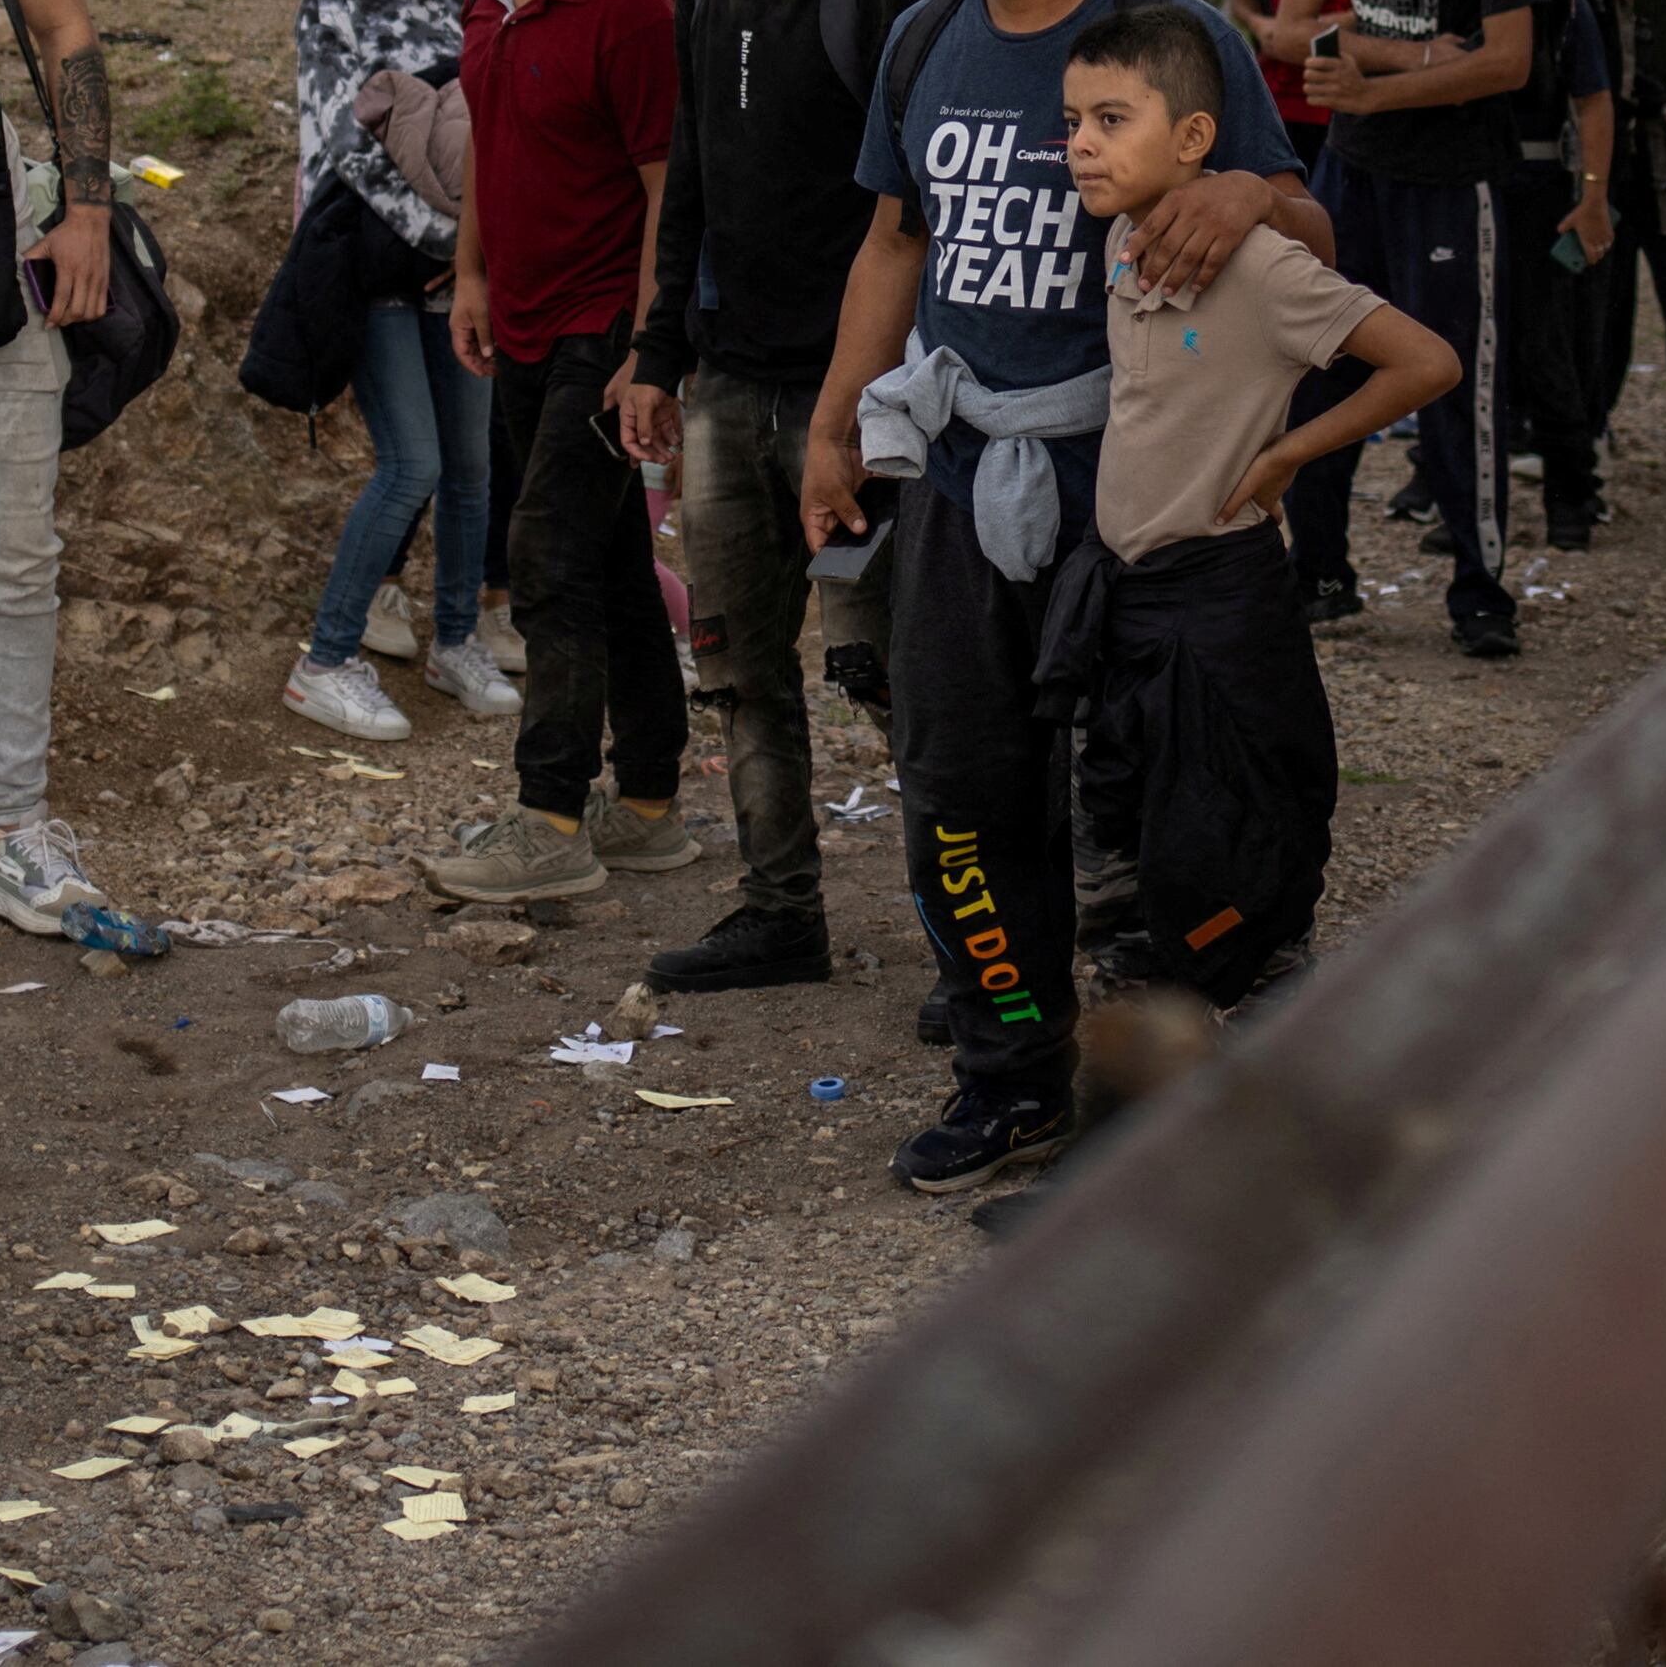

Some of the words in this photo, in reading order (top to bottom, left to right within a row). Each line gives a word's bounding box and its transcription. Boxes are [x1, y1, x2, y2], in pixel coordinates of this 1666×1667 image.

[939, 105, 949, 116] Do
[954, 107, 971, 117] work
[971, 108, 980, 117] at
[980, 108, 1006, 120] Capital
[1005, 109, 1023, 119] One?
[925, 120, 1017, 182] OH
[929, 181, 1081, 248] TECH
[935, 239, 1088, 310] YEAH
[935, 824, 996, 920] JUST
[965, 926, 1019, 991] DO
[991, 990, 1043, 1025] IT
